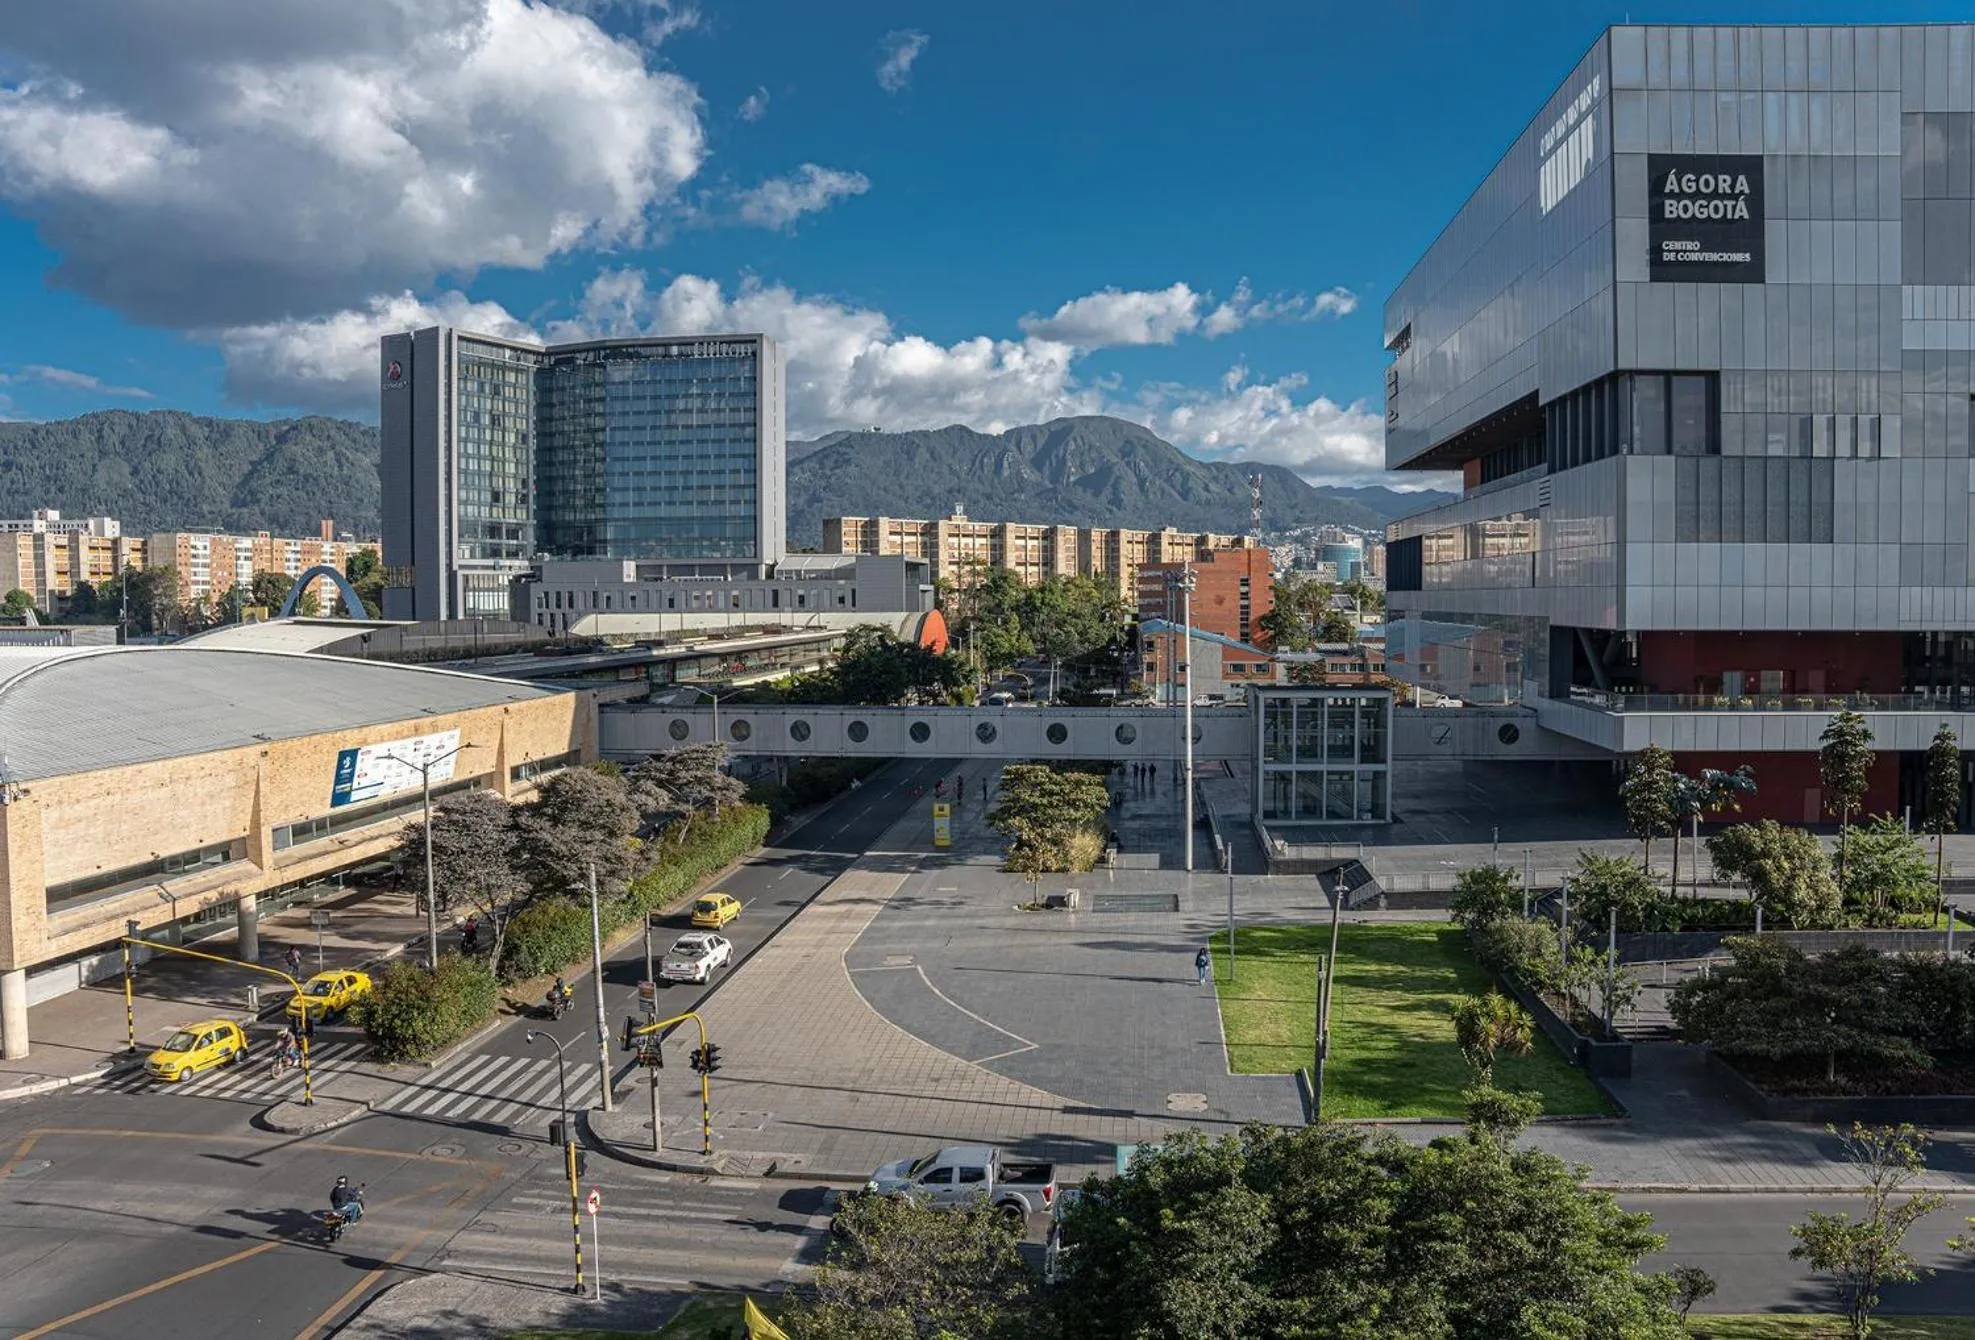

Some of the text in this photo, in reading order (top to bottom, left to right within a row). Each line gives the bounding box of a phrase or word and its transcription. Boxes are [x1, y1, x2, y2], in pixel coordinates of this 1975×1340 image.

[1663, 168, 1750, 193] ÁGORA
[1664, 195, 1749, 219] BOGOTÁ
[1662, 241, 1700, 251] CENTRO
[1663, 252, 1751, 262] DE CONVENCIONES
